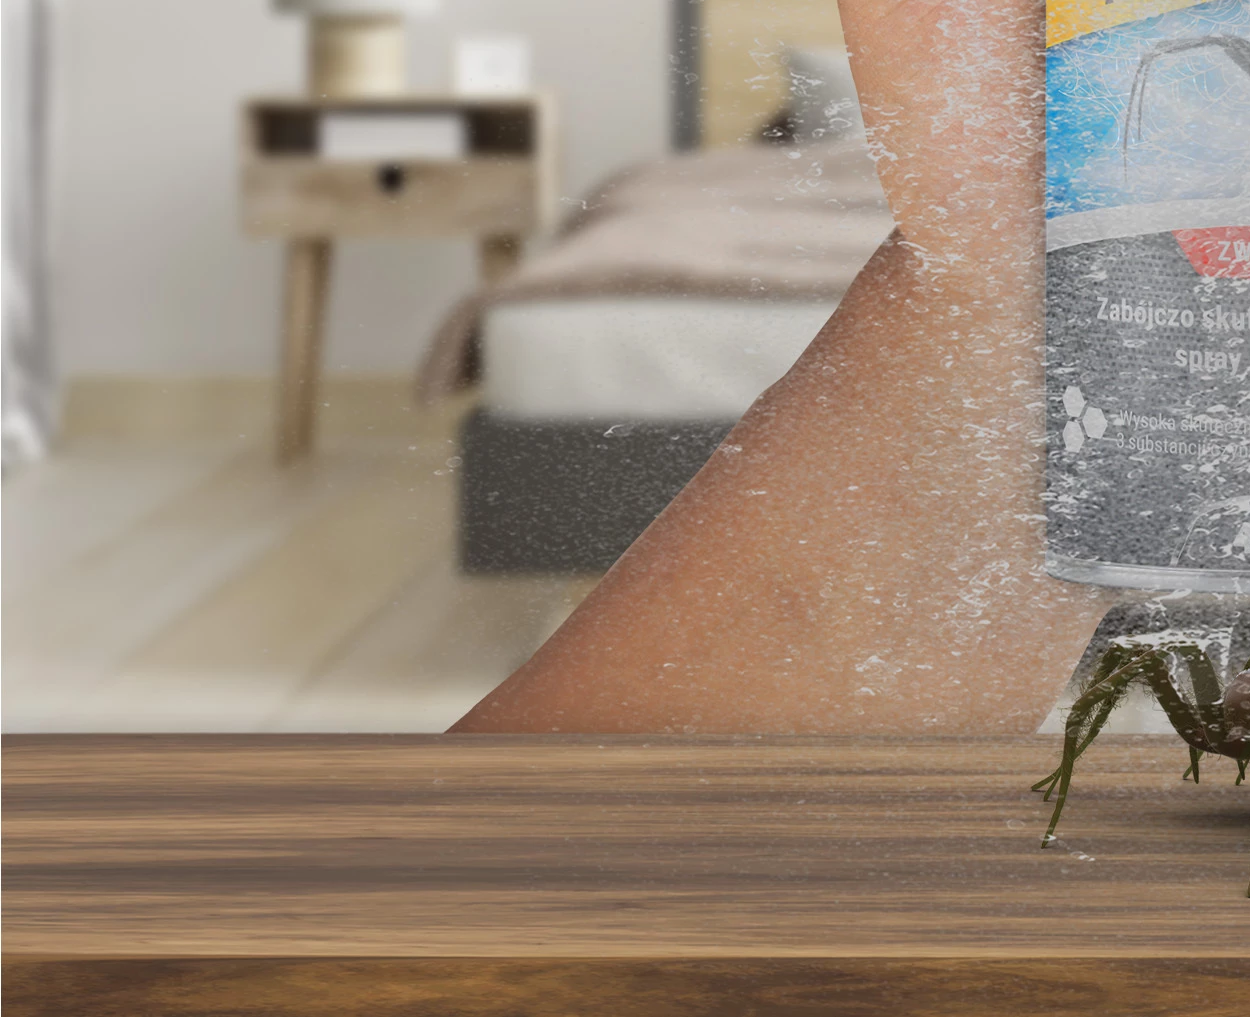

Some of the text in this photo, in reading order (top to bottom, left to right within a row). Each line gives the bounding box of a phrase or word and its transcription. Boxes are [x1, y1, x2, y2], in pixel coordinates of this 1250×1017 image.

[1096, 297, 1194, 331] Zabójczo
[1175, 349, 1242, 376] spray
[1119, 410, 1176, 432] Wysoka
